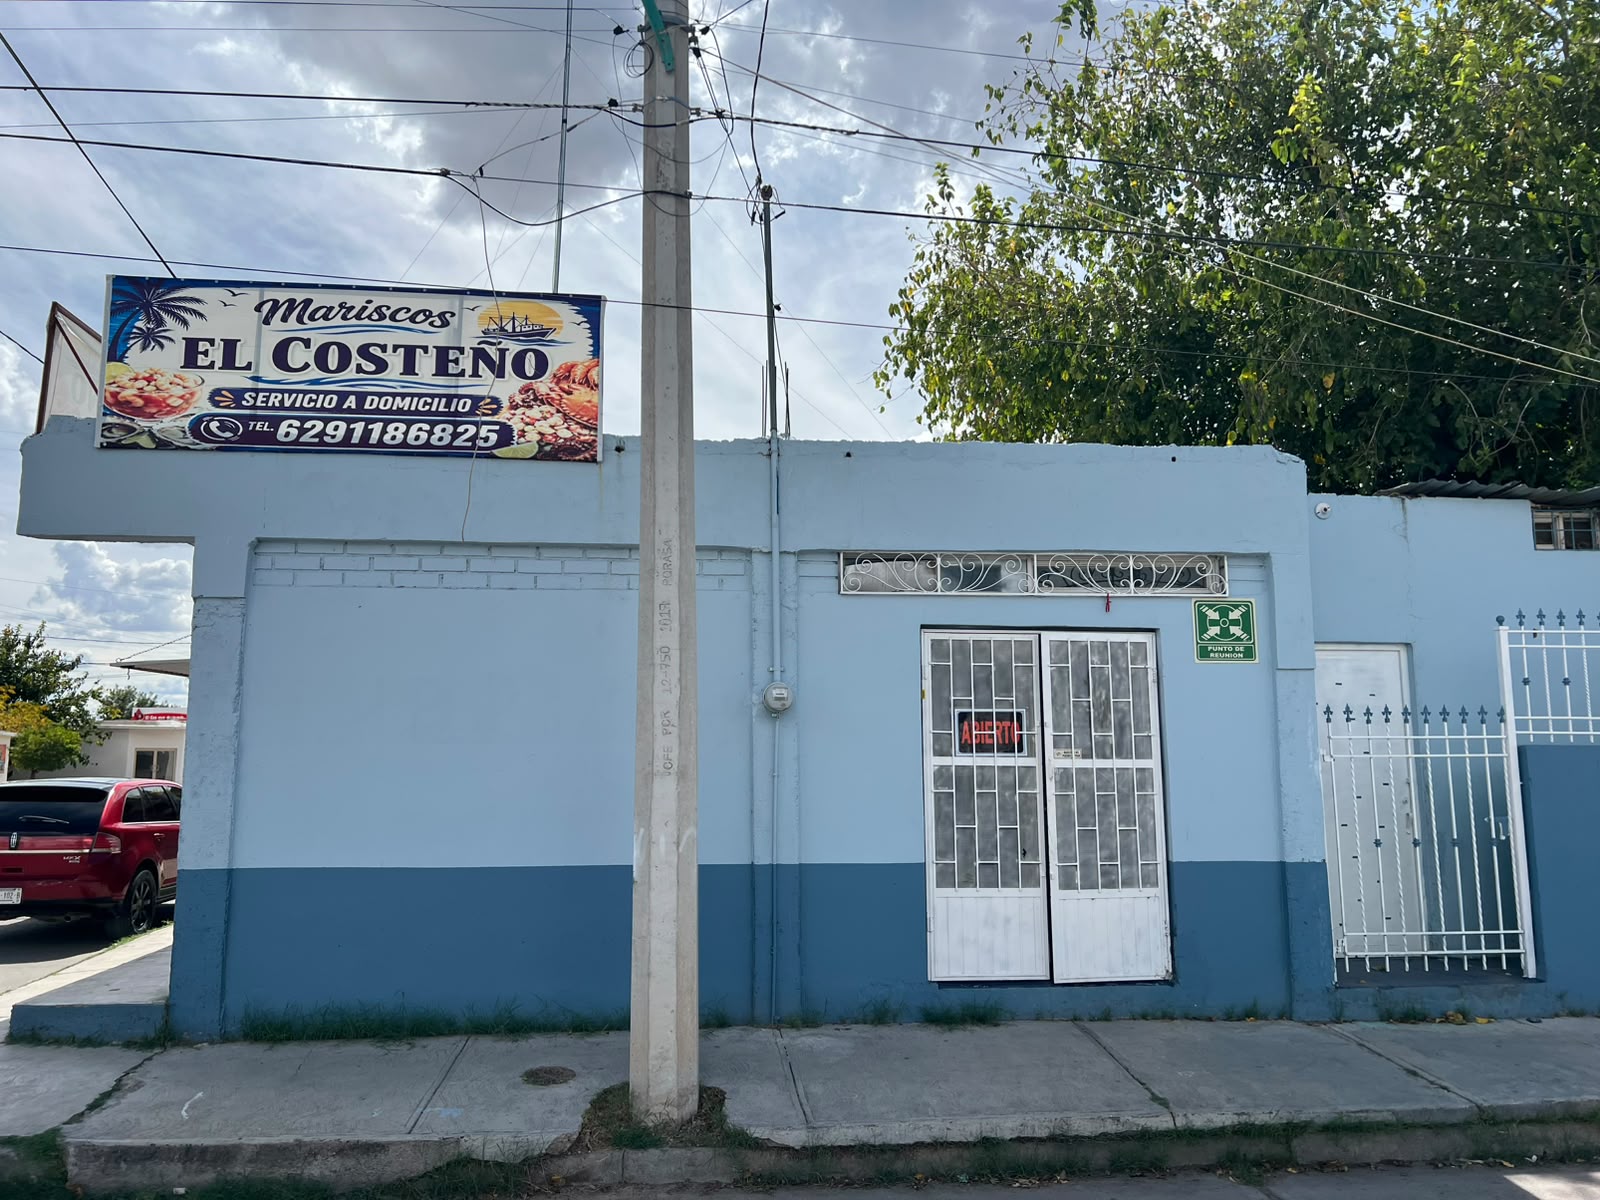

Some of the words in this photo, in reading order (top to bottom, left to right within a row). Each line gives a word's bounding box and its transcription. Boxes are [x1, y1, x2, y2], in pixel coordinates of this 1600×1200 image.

[253, 297, 456, 329] Mariscos
[180, 336, 253, 371] EL
[271, 336, 549, 381] COSTEÑO
[241, 391, 338, 409] SERVICIO
[342, 395, 357, 409] A
[363, 395, 472, 412] DOMICILIO
[248, 420, 275, 432] TEL.
[276, 419, 500, 448] 6291186825
[961, 720, 1021, 745] ABIERTO
